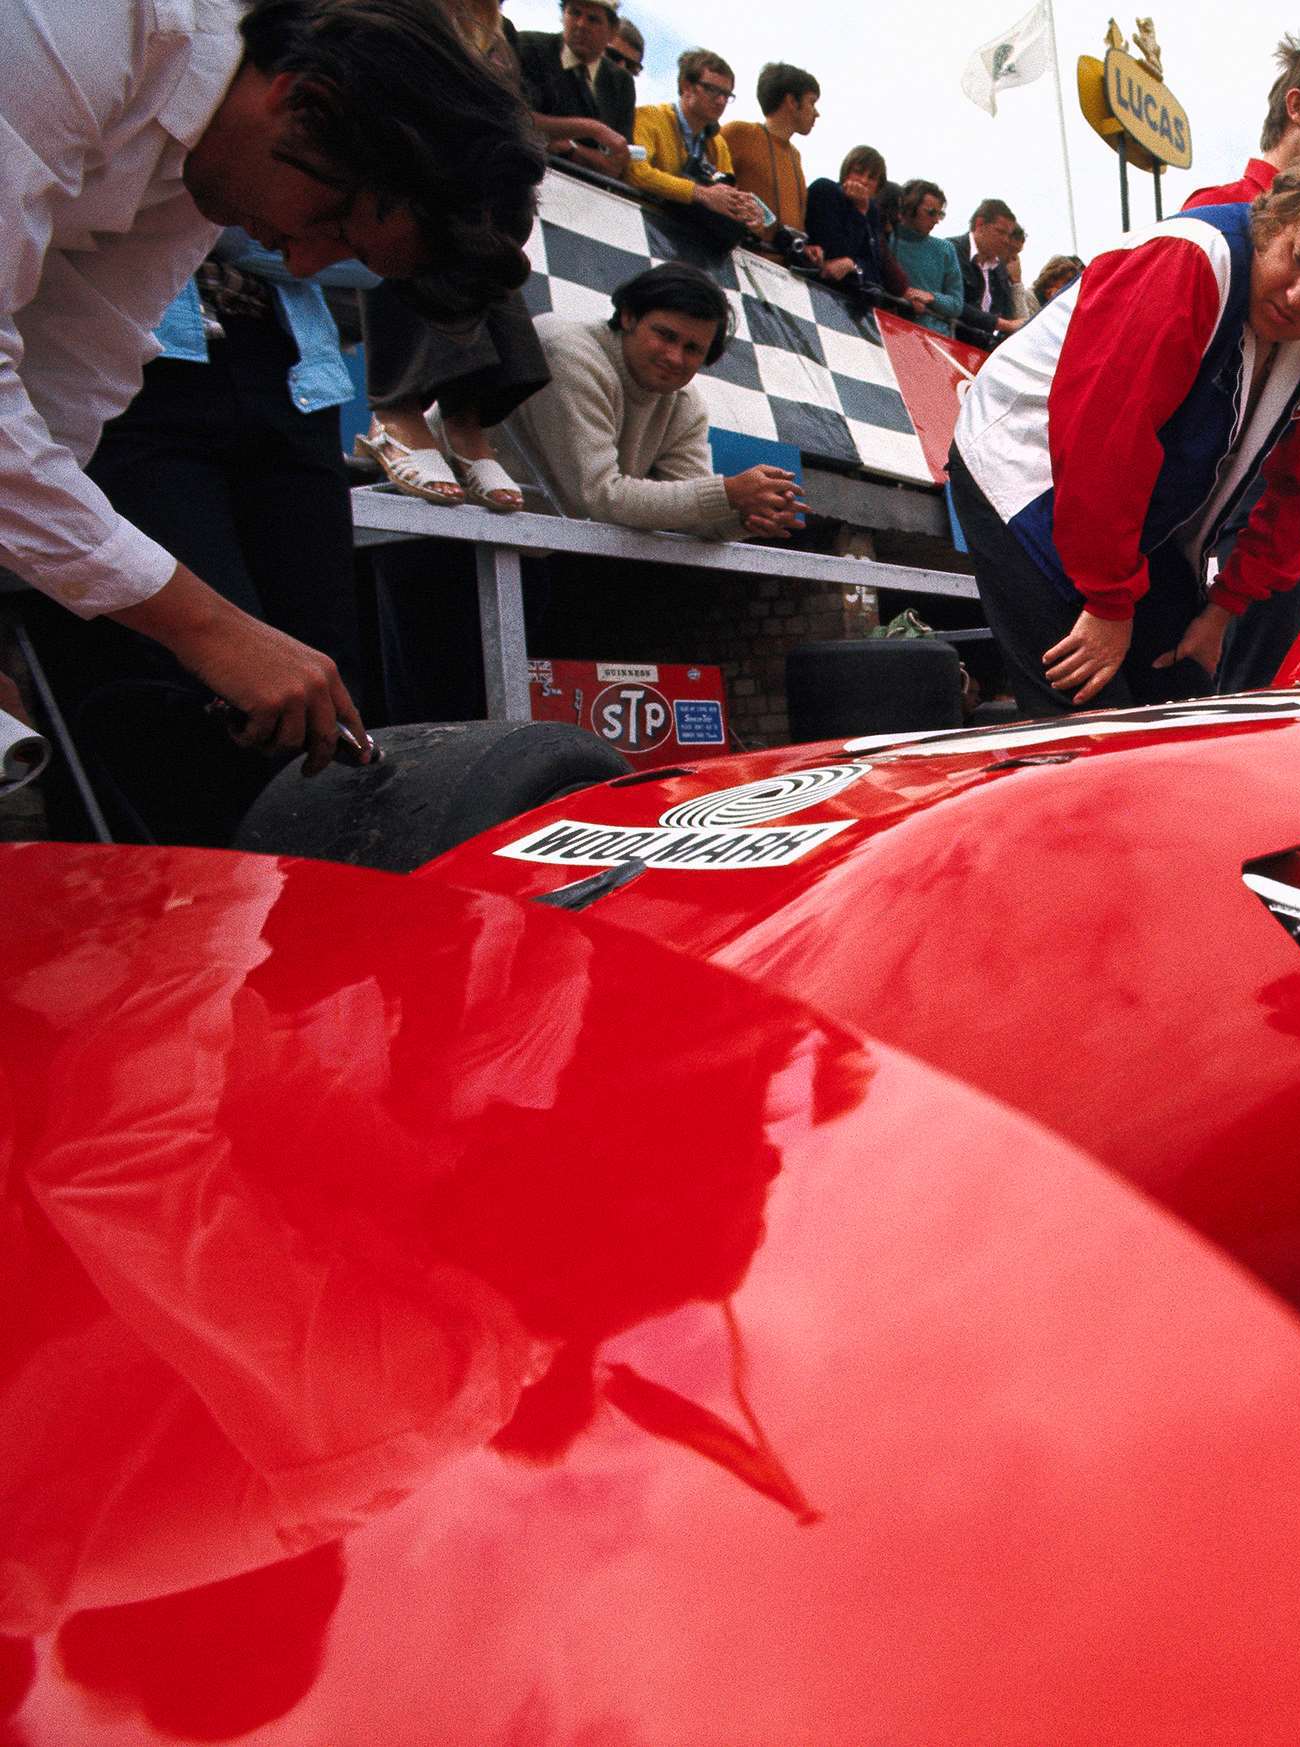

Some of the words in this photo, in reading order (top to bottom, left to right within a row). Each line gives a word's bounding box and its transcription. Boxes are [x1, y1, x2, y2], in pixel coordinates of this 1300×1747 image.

[1115, 68, 1186, 153] LUCAS
[602, 690, 666, 745] STP
[520, 824, 827, 865] WOOLMARK
